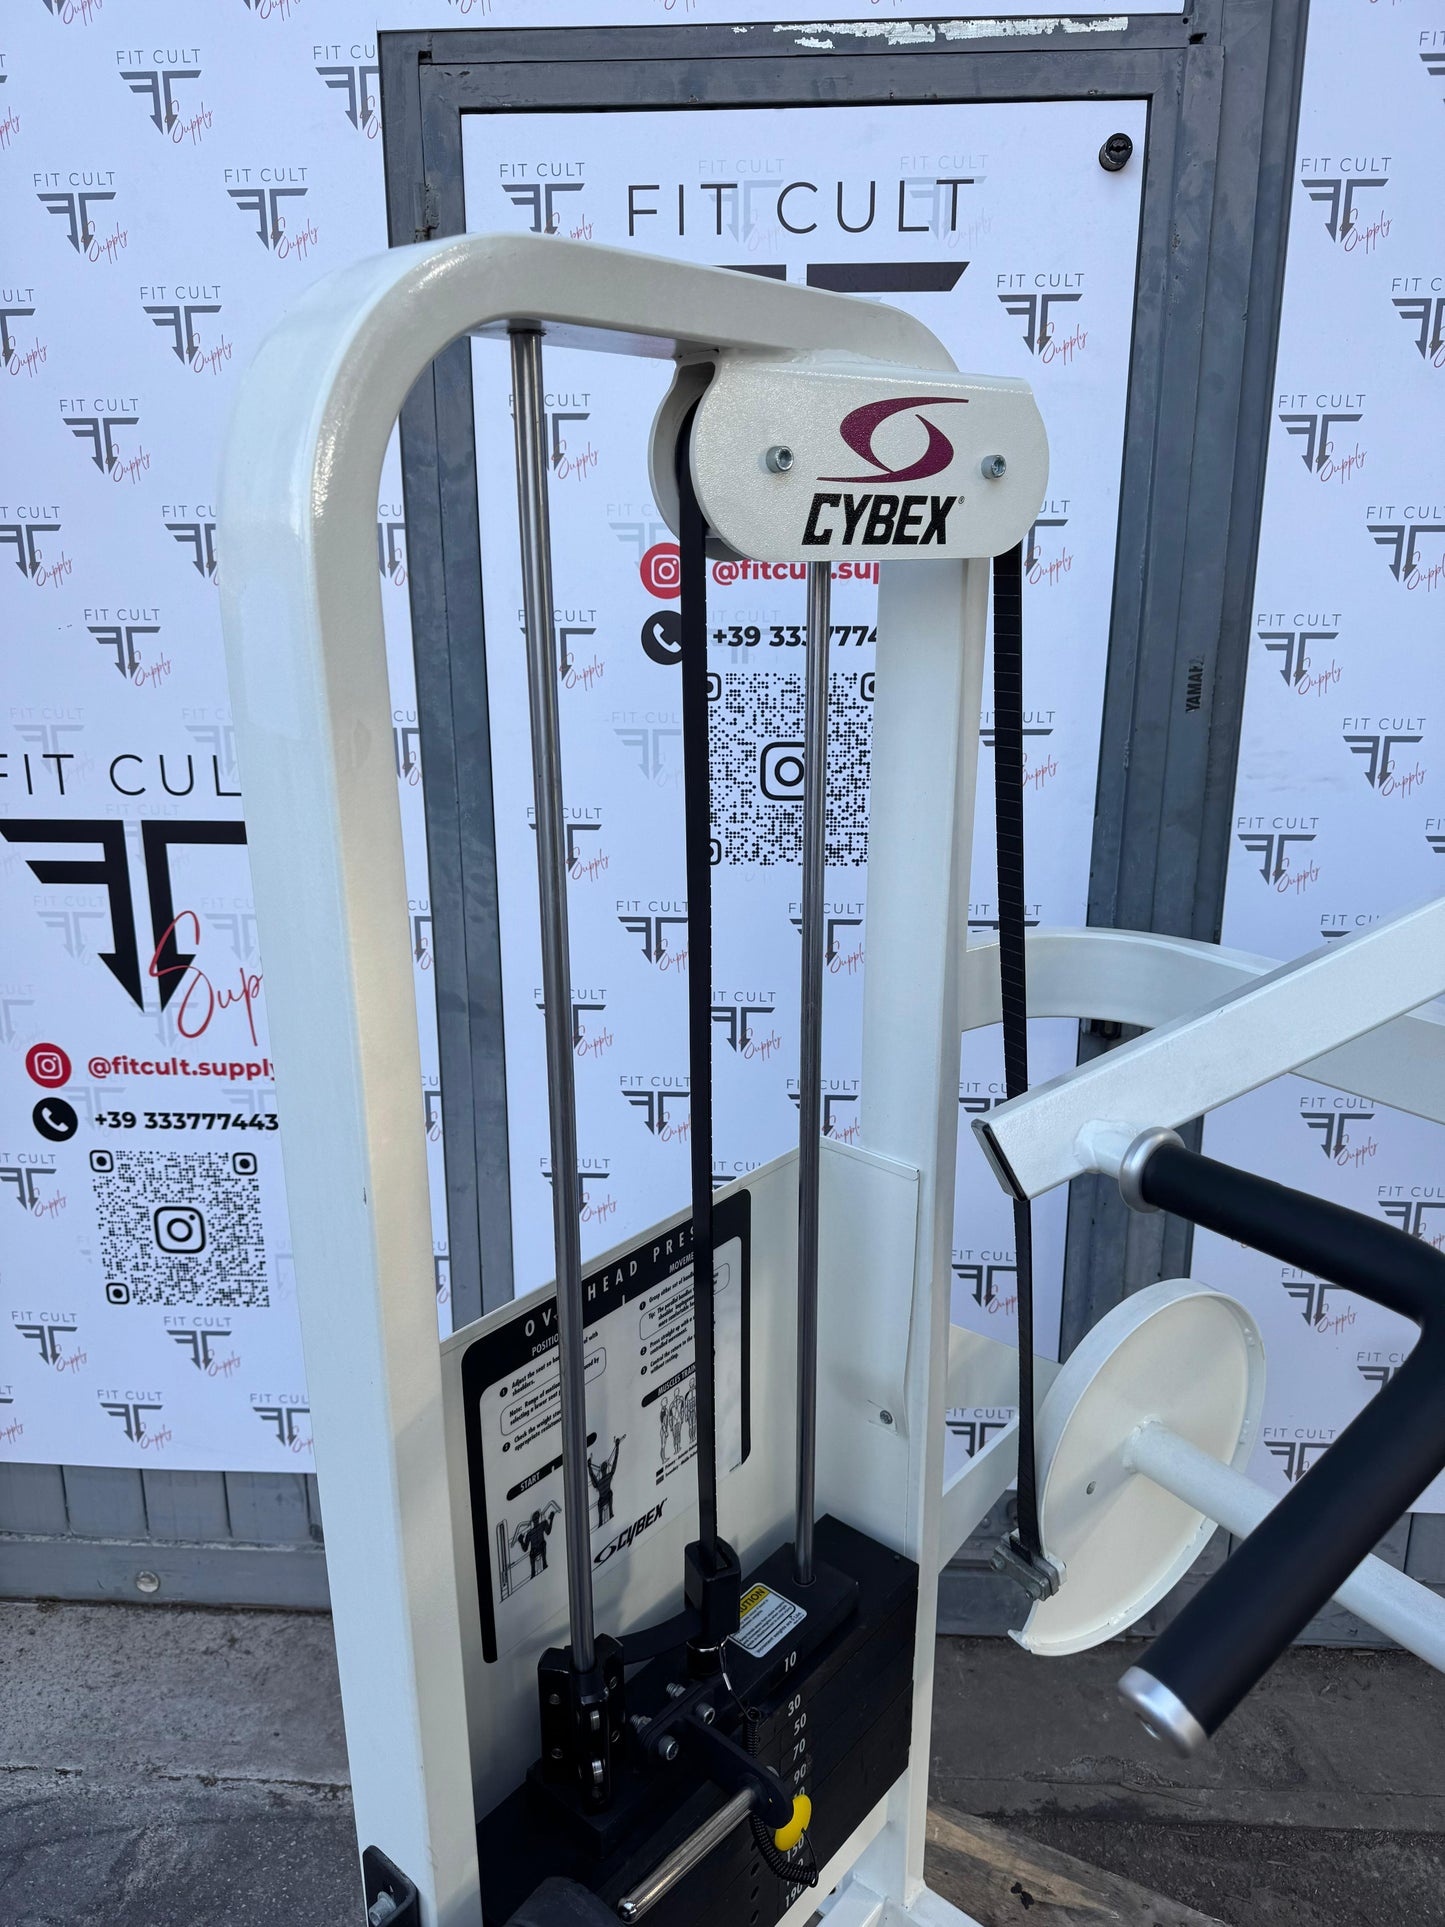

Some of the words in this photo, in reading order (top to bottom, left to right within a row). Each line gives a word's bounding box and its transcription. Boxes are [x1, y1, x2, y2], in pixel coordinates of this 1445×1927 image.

[116, 50, 144, 64] FIT
[153, 48, 200, 64] CULT
[313, 46, 341, 60] FIT
[350, 44, 376, 59] CU
[500, 163, 528, 178] FIT
[536, 162, 586, 178] CULT
[1301, 158, 1332, 172] FIT
[1340, 157, 1392, 172] CULT
[33, 173, 60, 187] FIT
[69, 172, 116, 186] CULT
[224, 168, 251, 183] FIT
[260, 168, 308, 182] CULT
[628, 184, 738, 236] FIT
[777, 180, 974, 234] CULT
[996, 273, 1025, 288] FIT
[1034, 272, 1085, 288] CULT
[1392, 278, 1422, 292] FIT
[2, 288, 34, 302] ULT
[140, 286, 166, 300] FIT
[174, 286, 221, 300] CULT
[60, 399, 84, 412] FIT
[94, 398, 139, 412] CULT
[544, 394, 591, 407] CULT
[1278, 395, 1308, 408] FIT
[1316, 394, 1366, 408] CULT
[17, 506, 60, 519] CULT
[162, 506, 186, 518] FIT
[1038, 500, 1070, 513] ULT
[1366, 506, 1396, 519] FIT
[84, 608, 109, 622] FIT
[116, 608, 160, 622] CULT
[552, 610, 598, 622] CULT
[1257, 614, 1284, 627] FIT
[1294, 614, 1342, 627] CULT
[712, 626, 761, 646] +39
[1185, 656, 1204, 714] YAMA
[1022, 711, 1056, 723] ULT
[1342, 718, 1370, 730] FIT
[1378, 718, 1426, 730] CULT
[110, 754, 242, 796] CUL
[561, 807, 602, 820] CULT
[1237, 817, 1264, 830] FIT
[1272, 817, 1319, 830] CULT
[1425, 818, 1445, 830] FI
[616, 901, 641, 912] FIT
[648, 901, 688, 912] CULT
[1320, 915, 1348, 926] FIT
[149, 910, 264, 1046] Sup
[734, 992, 776, 1002] CULT
[620, 1076, 644, 1086] FIT
[1300, 1096, 1326, 1108] FIT
[95, 1112, 137, 1129] +39
[18, 1154, 56, 1165] CULT
[1378, 1186, 1404, 1196] FIT
[1410, 1186, 1445, 1198] CUL
[669, 1252, 694, 1273] MOVEME
[524, 1260, 638, 1337] OVHEAD
[654, 1226, 694, 1262] PRE
[12, 1311, 32, 1322] FIT
[40, 1312, 78, 1323] CULT
[164, 1316, 186, 1327] FIT
[192, 1316, 232, 1328] CULT
[532, 1333, 559, 1356] POSITIO
[1356, 1352, 1382, 1362] FIT
[658, 1373, 680, 1396] MUSCLES
[97, 1389, 118, 1400] FIT
[126, 1390, 163, 1402] CULT
[250, 1394, 271, 1404] FIT
[974, 1408, 1015, 1420] CULT
[1264, 1428, 1288, 1438] FIT
[1294, 1429, 1336, 1440] CULT
[520, 1472, 540, 1492] START
[617, 1498, 668, 1552] CYBEX
[740, 1588, 766, 1612] UTION
[784, 1650, 797, 1672] 10
[788, 1694, 800, 1717] 30
[794, 1712, 807, 1736] 50
[792, 1738, 806, 1761] 70
[794, 1764, 807, 1784] 90
